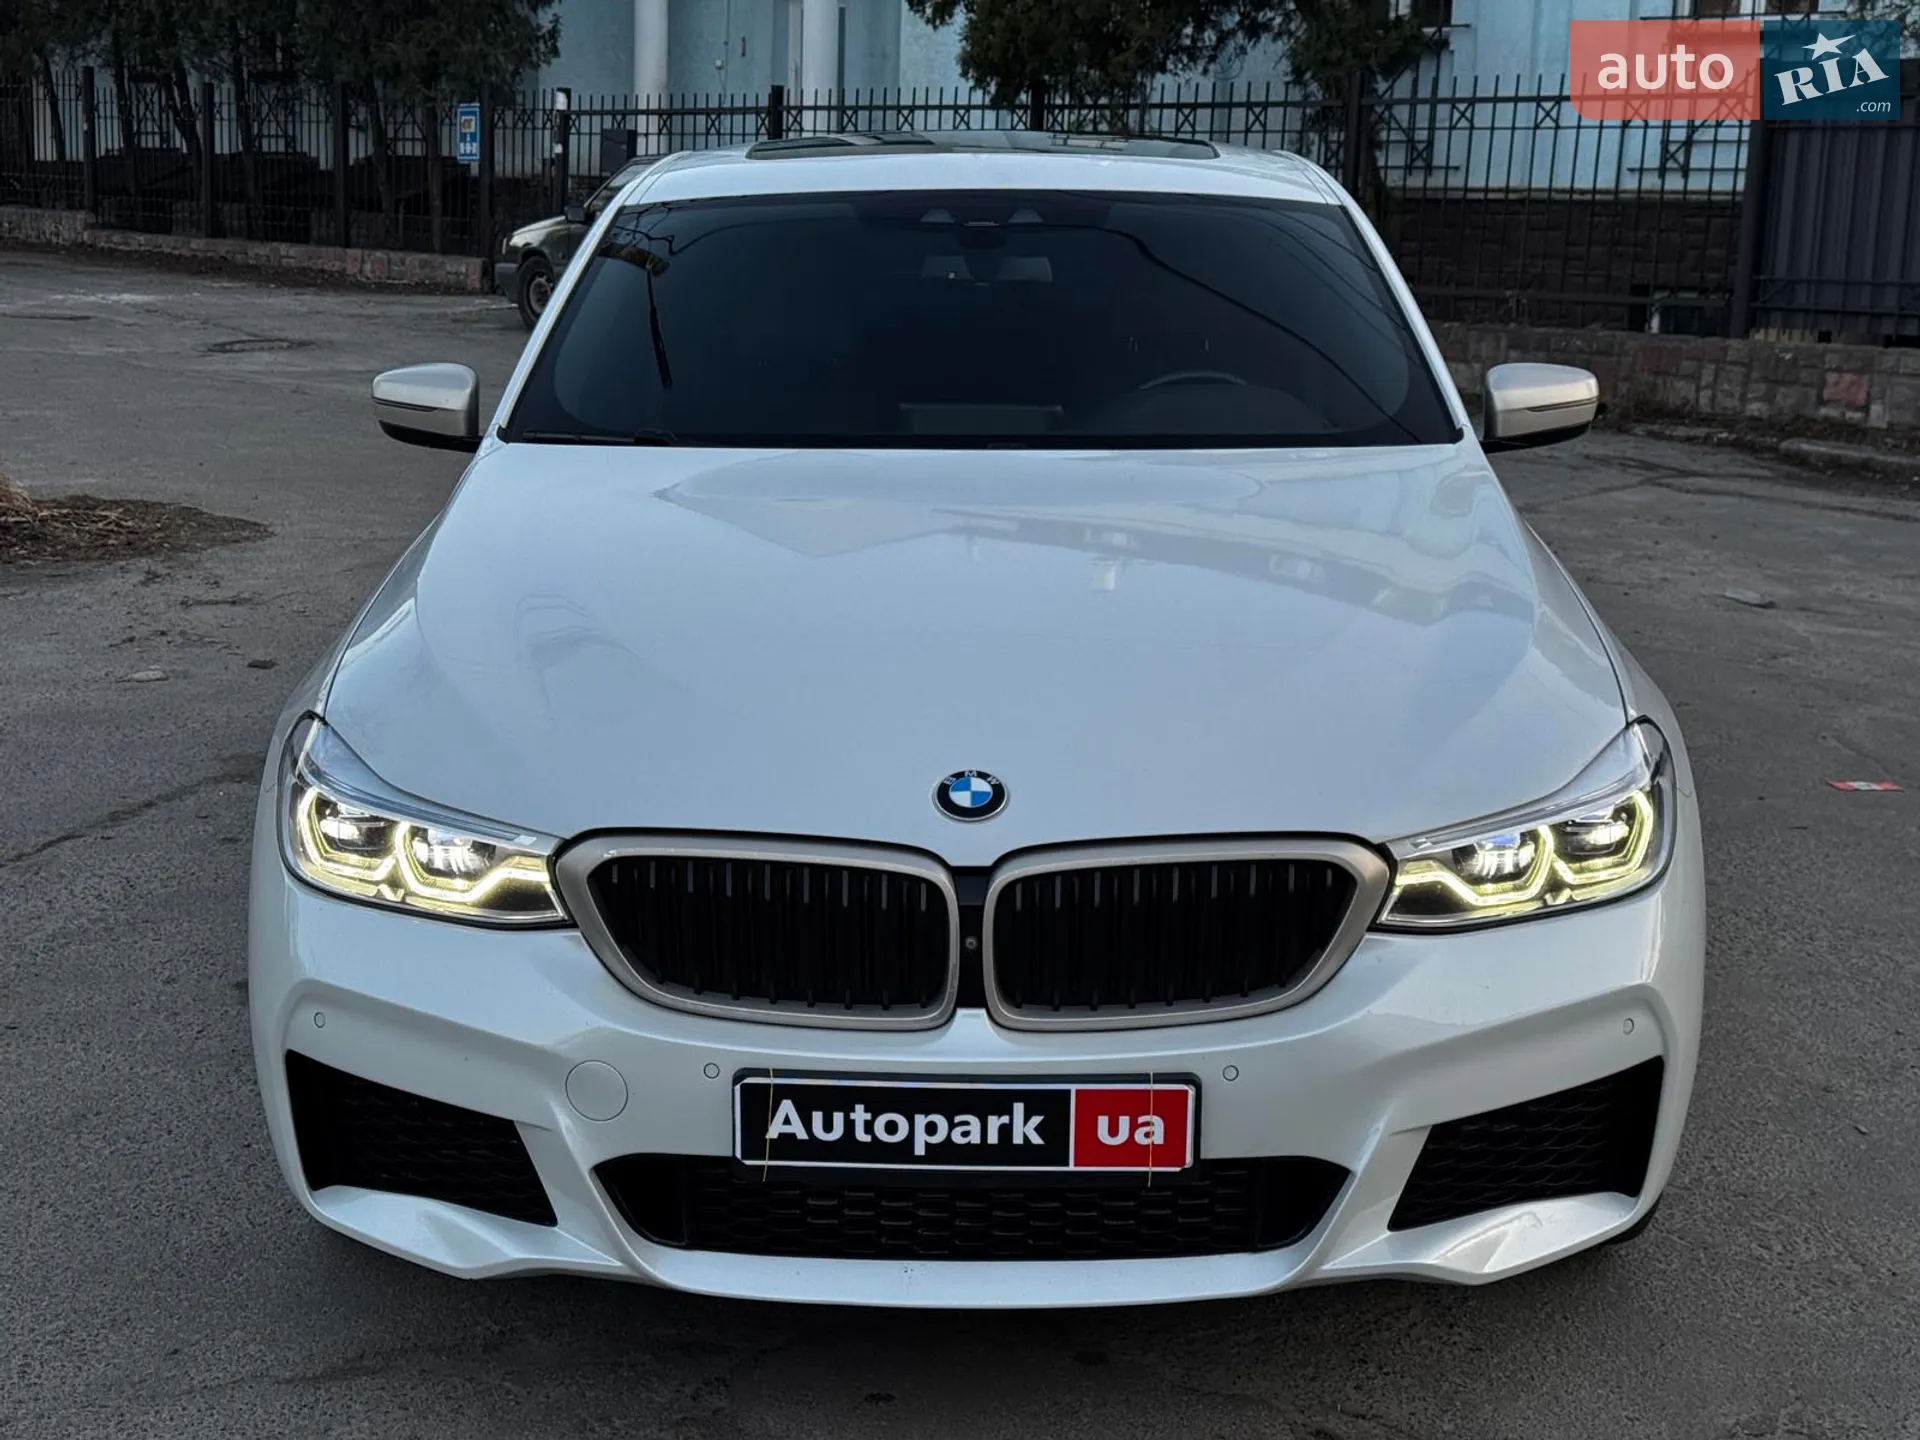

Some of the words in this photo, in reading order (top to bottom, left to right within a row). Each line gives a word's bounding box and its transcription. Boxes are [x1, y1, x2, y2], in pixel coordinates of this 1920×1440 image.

[942, 769, 1000, 785] BMW
[766, 1099, 1046, 1156] Autopark
[1097, 1115, 1165, 1146] ua
